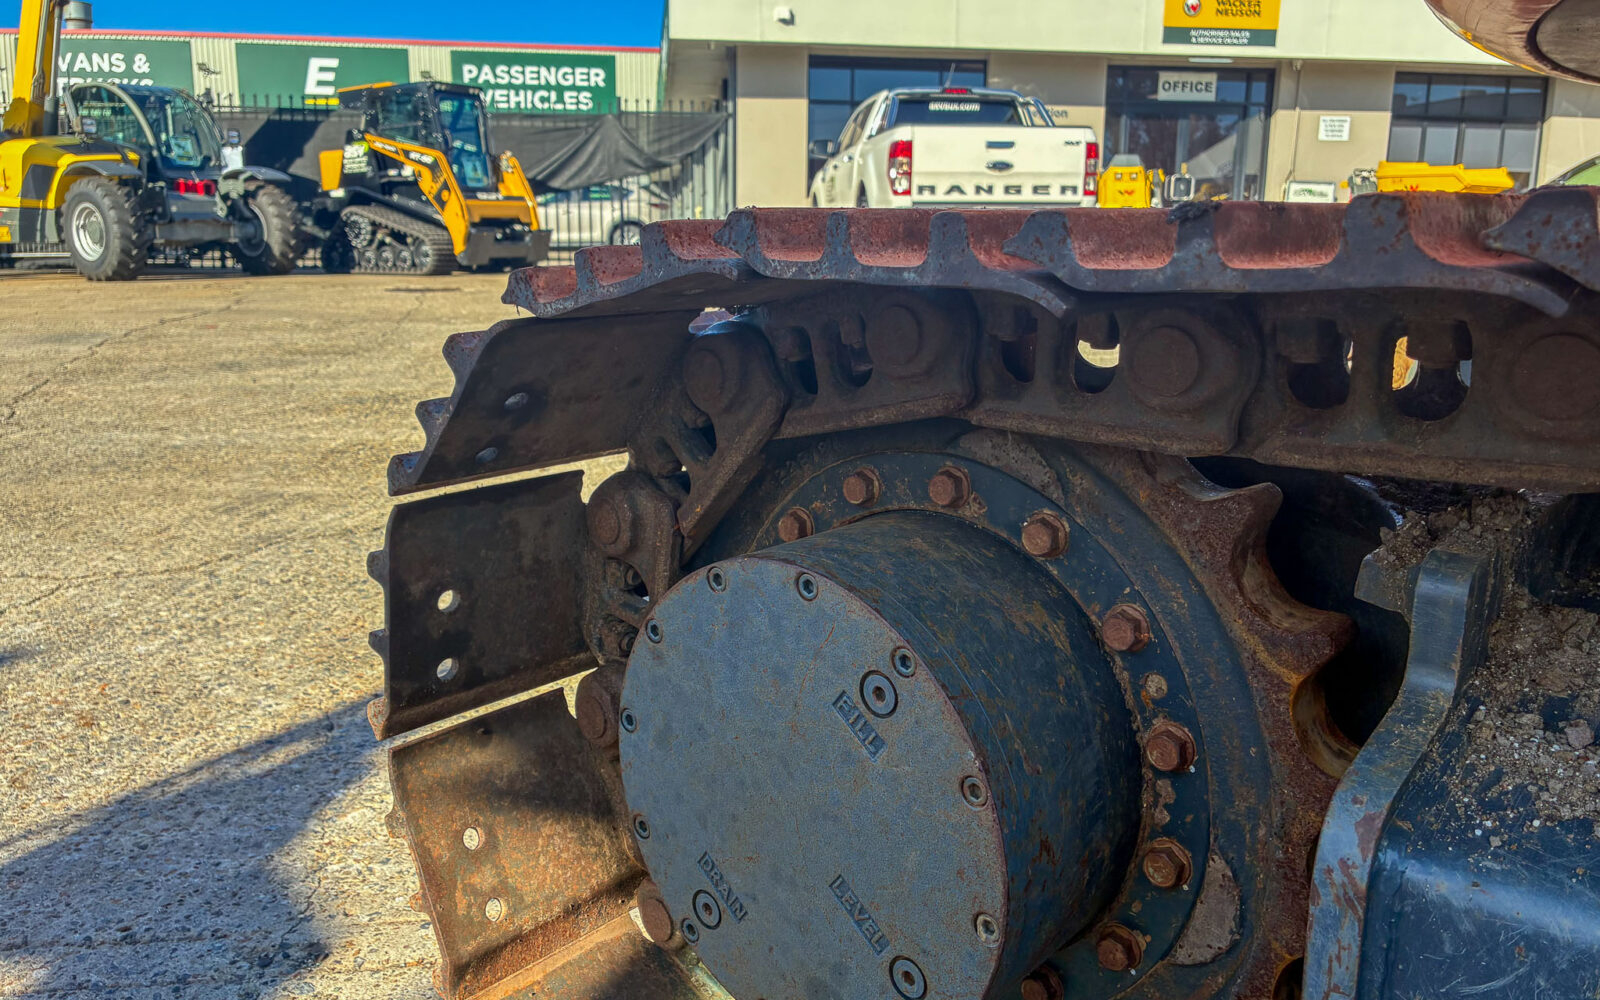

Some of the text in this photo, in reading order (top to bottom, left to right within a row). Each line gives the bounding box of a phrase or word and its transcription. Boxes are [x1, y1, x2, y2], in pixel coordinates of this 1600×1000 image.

[1216, 8, 1261, 17] NEUSON
[58, 52, 150, 74] VANS &
[304, 57, 340, 96] E
[462, 64, 606, 87] PASSENGER
[1162, 81, 1214, 93] OFFICE
[479, 89, 594, 111] VEHICLES
[917, 184, 1078, 196] RANGER
[836, 694, 882, 757] FILL
[701, 854, 747, 921] DRAIN
[832, 877, 888, 951] LEVEL
